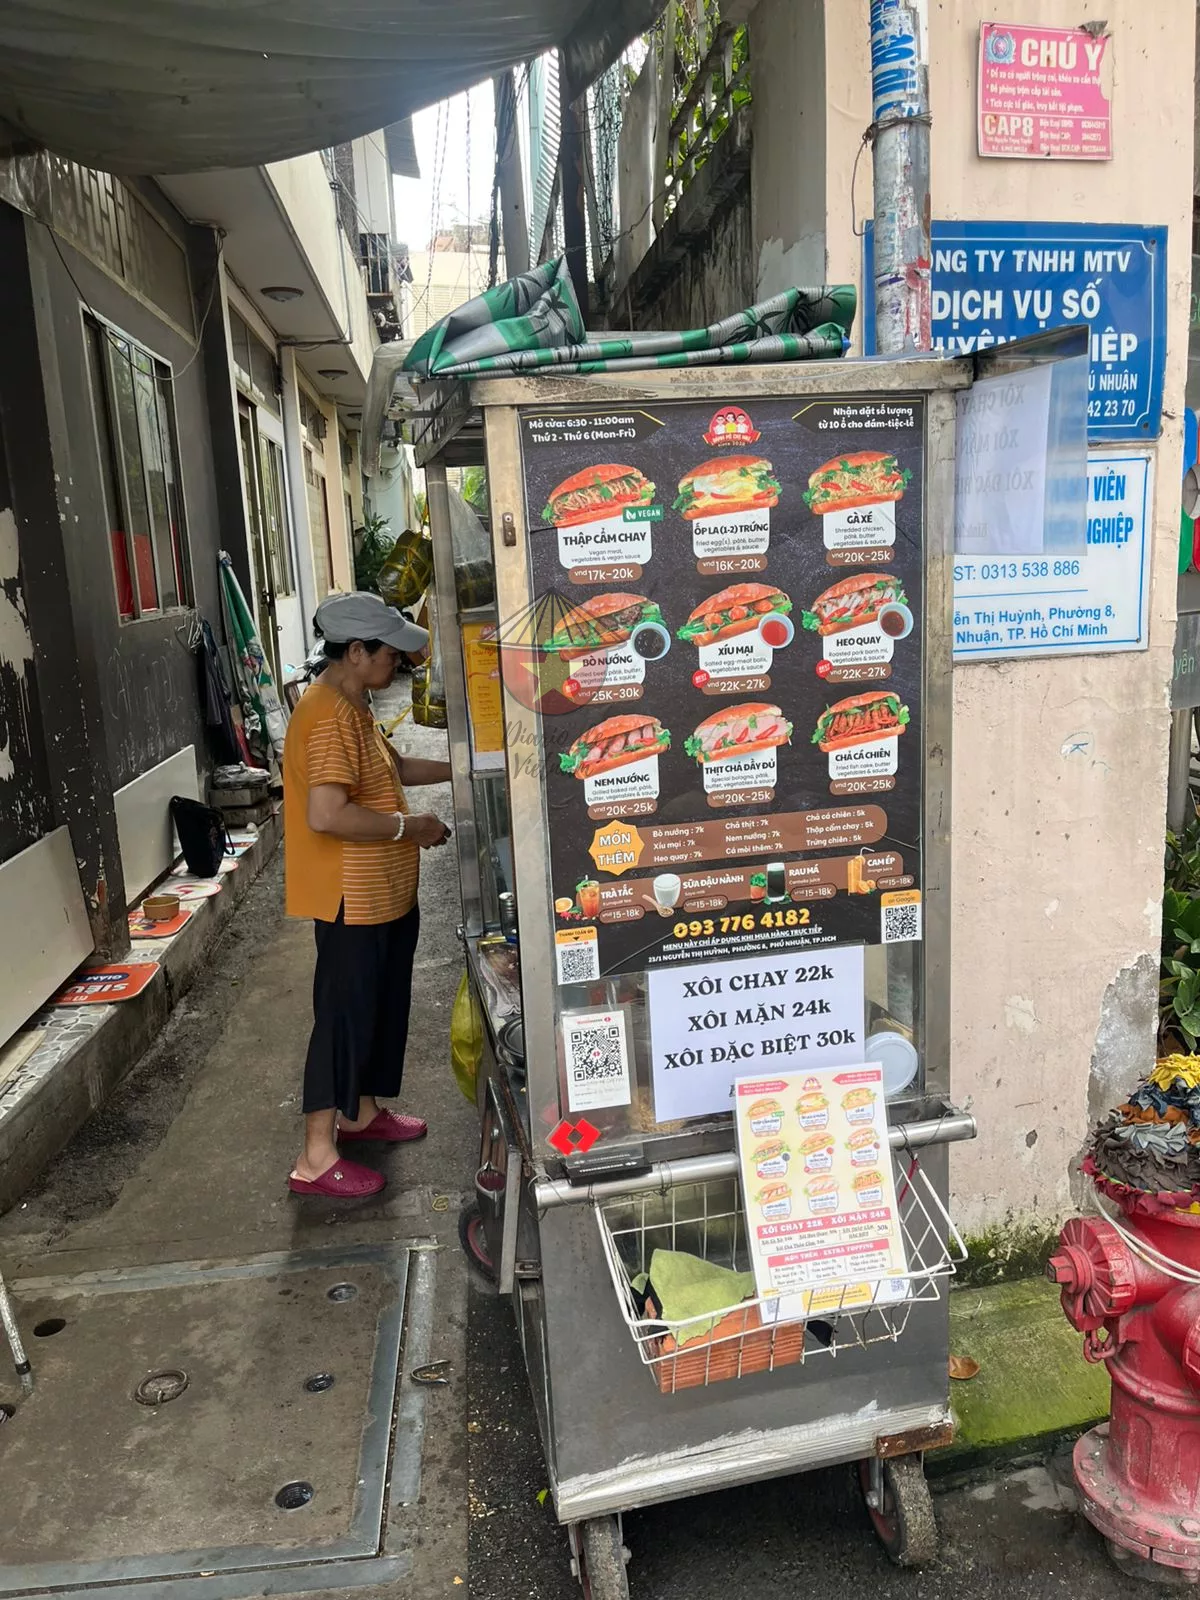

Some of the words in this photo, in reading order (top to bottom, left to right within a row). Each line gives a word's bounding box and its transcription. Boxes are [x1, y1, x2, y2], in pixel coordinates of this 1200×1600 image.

[1022, 36, 1076, 69] CHÚ
[984, 115, 1033, 137] CAP8
[931, 250, 967, 272] NG
[974, 250, 1005, 272] TY
[1012, 250, 1074, 272] TNHH
[1084, 250, 1131, 272] MTV
[931, 290, 1003, 329] DỊCH
[1013, 290, 1052, 328] VỤ
[1062, 279, 1102, 319] SỐ
[1100, 369, 1137, 393] NHUẬN
[833, 407, 857, 417] Nhận
[859, 406, 875, 417] đặt
[876, 404, 886, 414] số
[887, 407, 912, 416] lượng
[1104, 400, 1118, 416] 23
[1122, 400, 1135, 415] 70
[529, 419, 543, 429] Mở
[545, 418, 566, 427] cửa:
[567, 419, 587, 427] 6:30
[594, 417, 634, 425] 11:00am
[819, 420, 828, 429] từ
[532, 433, 551, 442] Thứ
[564, 431, 582, 440] Thứ
[591, 428, 636, 440] (Mon-Fri)
[1094, 470, 1126, 501] VIÊN
[638, 509, 660, 517] VEGAN
[847, 512, 859, 523] GÀ
[861, 511, 872, 523] XÉ
[694, 522, 707, 535] ỐP
[720, 525, 738, 534] (1-2)
[739, 521, 768, 532] TRỨNG
[563, 532, 592, 548] THẬP
[594, 528, 616, 543] CẨM
[618, 532, 646, 542] CHAY
[845, 551, 890, 562] 20K-25k
[716, 559, 760, 571] 16K-20k
[981, 563, 1017, 580] 0313
[1022, 561, 1048, 578] 538
[1053, 560, 1080, 576] 886
[588, 568, 633, 580] 17k-20k
[975, 611, 995, 626] Thị
[999, 608, 1045, 625] Huỳnh,
[1049, 606, 1101, 623] Phường
[1105, 605, 1116, 620] 8,
[837, 638, 855, 646] HEO
[856, 636, 881, 646] QUAY
[956, 628, 1003, 645] Nhuận,
[1007, 627, 1027, 640] TP.
[1030, 624, 1048, 639] Hồ
[1052, 624, 1073, 638] Chí
[1077, 623, 1108, 636] Minh
[718, 644, 734, 655] XÍU
[736, 646, 753, 656] MẠI
[583, 656, 597, 667] BÒ
[598, 653, 632, 665] NƯỚNG
[842, 667, 886, 679] 22K-27k
[721, 679, 765, 691] 22K-27k
[592, 688, 640, 701] 25K-30k
[835, 751, 852, 761] CHẢ
[854, 750, 864, 760] CÁ
[865, 748, 890, 759] CHIÊN
[705, 766, 724, 775] THỊT
[725, 761, 742, 772] CHẢ
[744, 759, 760, 770] ĐẦY
[762, 759, 775, 769] ĐỦ
[595, 779, 614, 787] NEM
[616, 773, 650, 784] NƯỚNG
[847, 780, 891, 791] 20K-25k
[725, 791, 771, 803] 20K-25k
[606, 803, 653, 816] 20K-25k
[600, 831, 631, 846] MÓN
[665, 828, 689, 836] nướng
[744, 832, 767, 840] nướng
[598, 851, 635, 866] THÊM
[670, 853, 688, 861] quay
[867, 859, 885, 867] CAM
[886, 855, 895, 864] ÉP
[789, 868, 805, 876] RAU
[806, 864, 819, 874] MÁ
[683, 880, 700, 889] SỮA
[701, 877, 719, 888] ĐẬU
[720, 875, 744, 884] NÀNH
[601, 889, 617, 899] TRÀ
[618, 885, 633, 896] TẮC
[673, 919, 714, 938] 093
[720, 914, 755, 933] 776
[760, 908, 810, 927] 4182
[663, 943, 683, 951] MENU
[663, 951, 690, 960] NGUYỄN
[704, 947, 730, 955] HUỲNH,
[732, 943, 761, 952] PHƯỜNG
[770, 939, 784, 948] PHÚ
[786, 937, 811, 947] NHUẬN,
[683, 977, 722, 1000] XÔI
[729, 969, 789, 991] CHAY
[794, 964, 834, 981] 22k
[688, 1012, 727, 1033] XÔI
[735, 1002, 786, 1026] MẶN
[792, 998, 831, 1018] 24k
[664, 1047, 704, 1071] XÔI
[710, 1040, 755, 1065] ĐẶC
[761, 1033, 811, 1057] BIỆT
[817, 1029, 856, 1047] 30k
[762, 1225, 778, 1235] XÔI
[780, 1222, 804, 1232] CHAY
[831, 1215, 847, 1225] XÔI
[870, 1209, 887, 1218] 24K
